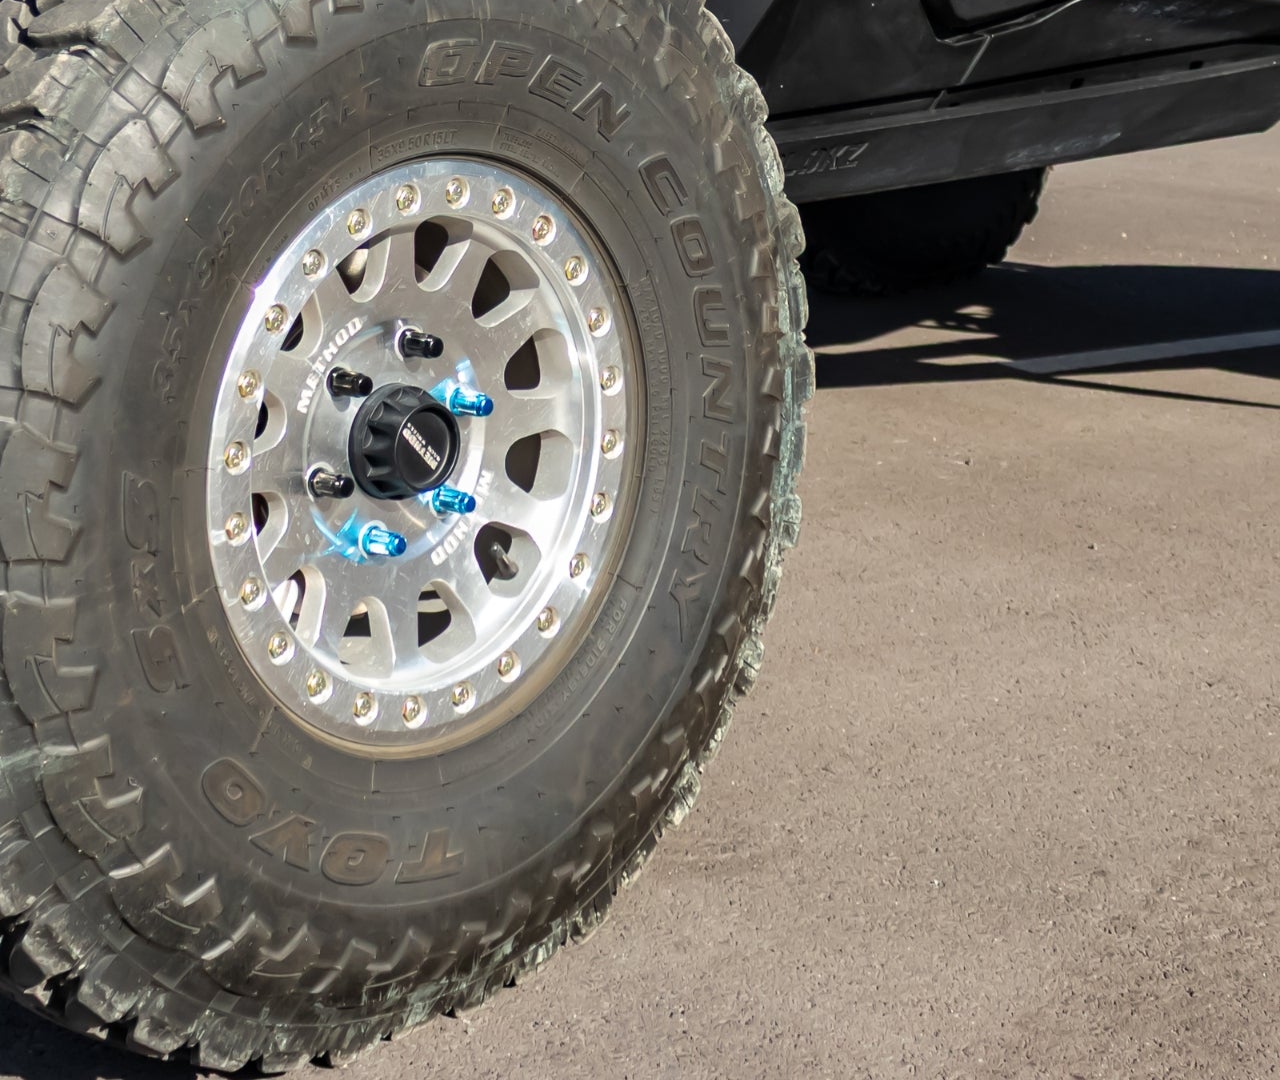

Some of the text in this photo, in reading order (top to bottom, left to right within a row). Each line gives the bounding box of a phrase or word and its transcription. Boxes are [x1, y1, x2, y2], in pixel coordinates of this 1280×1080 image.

[297, 317, 366, 414] METHOD
[419, 39, 632, 142] OPEN
[638, 152, 734, 642] COUNTRY
[201, 757, 466, 886] TOYO
